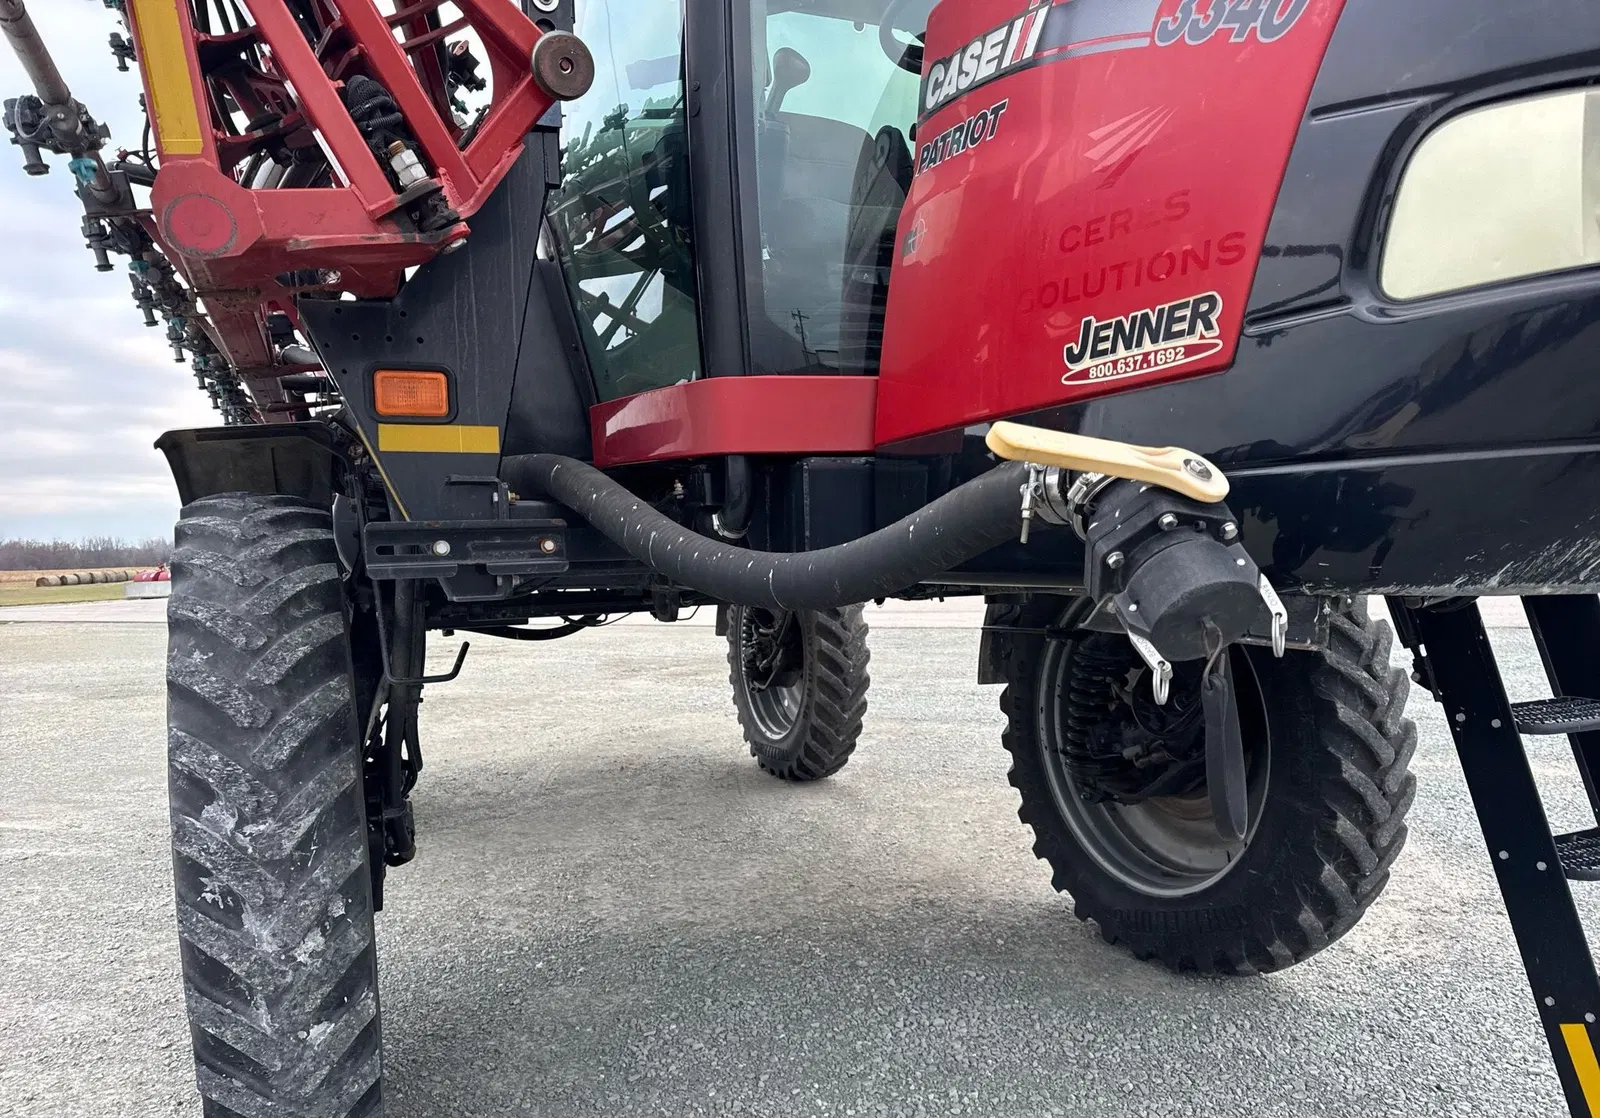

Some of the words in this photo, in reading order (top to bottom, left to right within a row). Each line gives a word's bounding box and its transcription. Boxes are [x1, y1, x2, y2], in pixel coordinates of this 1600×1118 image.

[915, 98, 1009, 177] PATRIOT
[1059, 188, 1192, 254] CERS
[1065, 292, 1221, 366] JENNER
[1088, 346, 1185, 380] 800.637.1692
